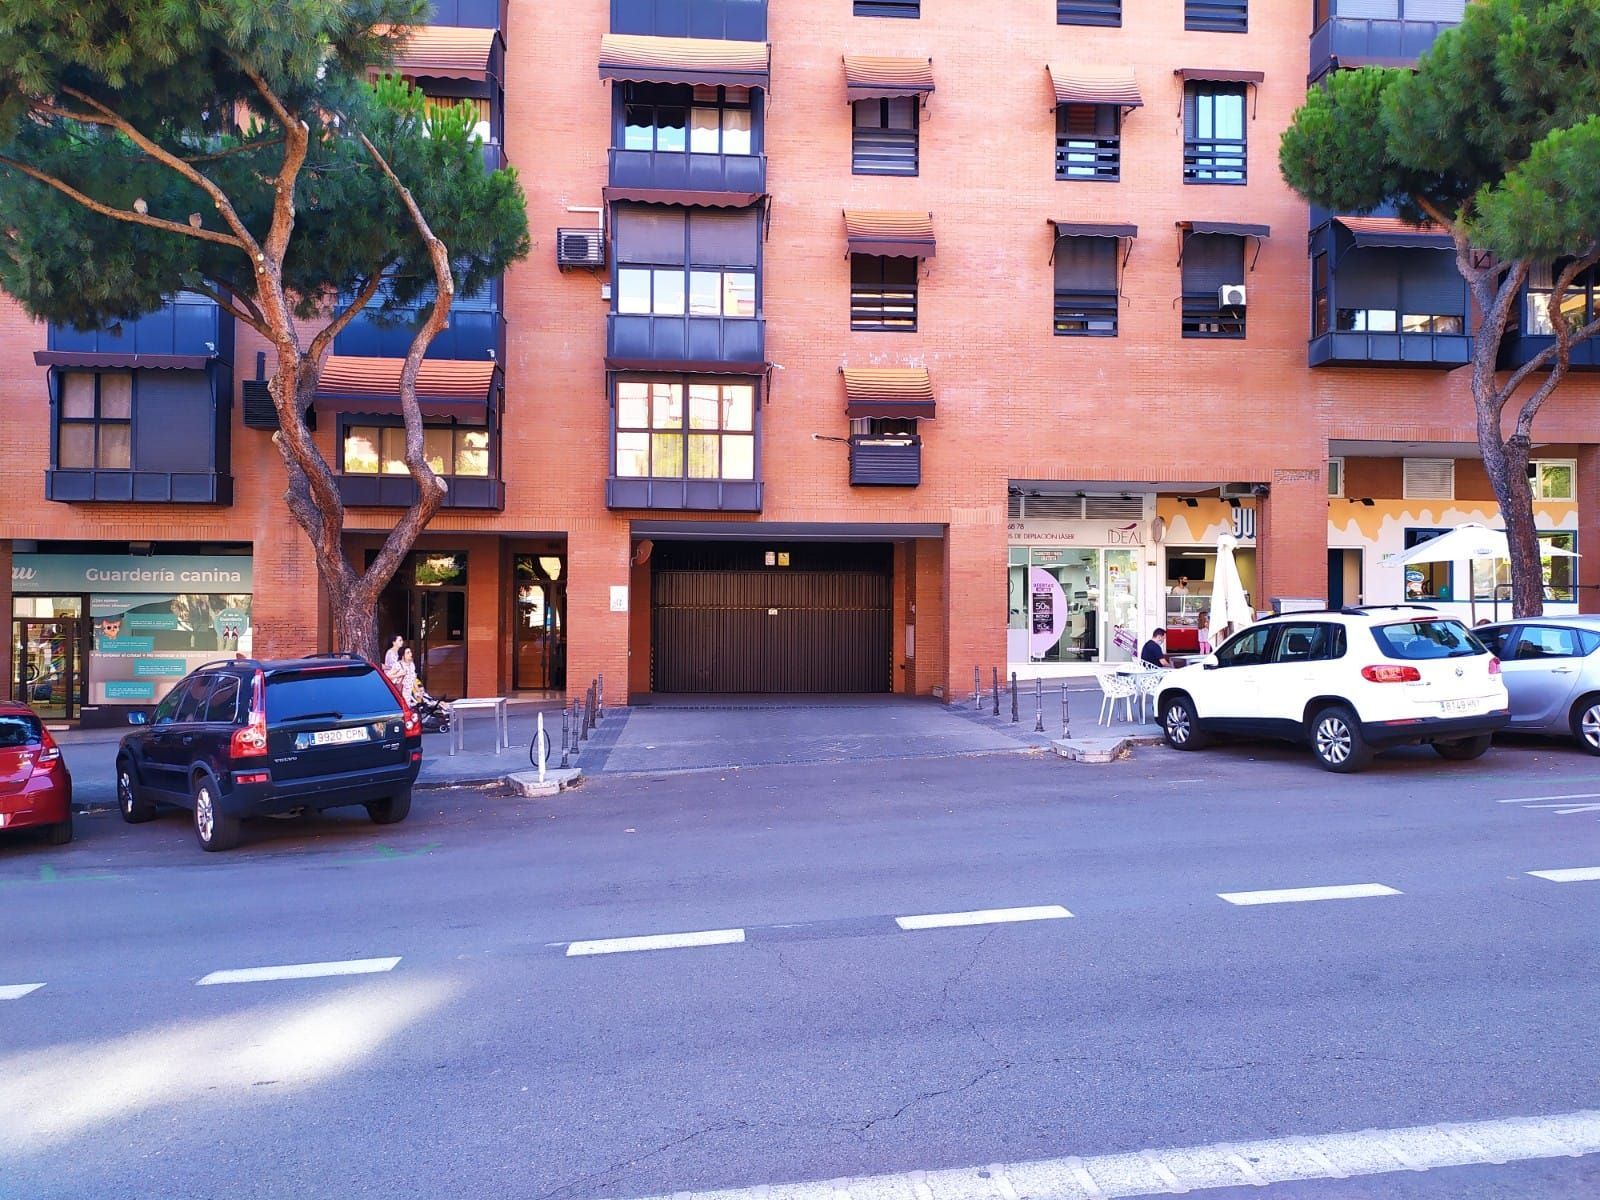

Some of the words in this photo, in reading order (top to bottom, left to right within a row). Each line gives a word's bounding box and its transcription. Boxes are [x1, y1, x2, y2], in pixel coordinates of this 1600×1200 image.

[1107, 529, 1144, 544] IDEAL
[85, 567, 175, 583] Guardería
[180, 567, 241, 583] canina
[317, 730, 343, 742] 9920
[345, 727, 364, 739] CPN
